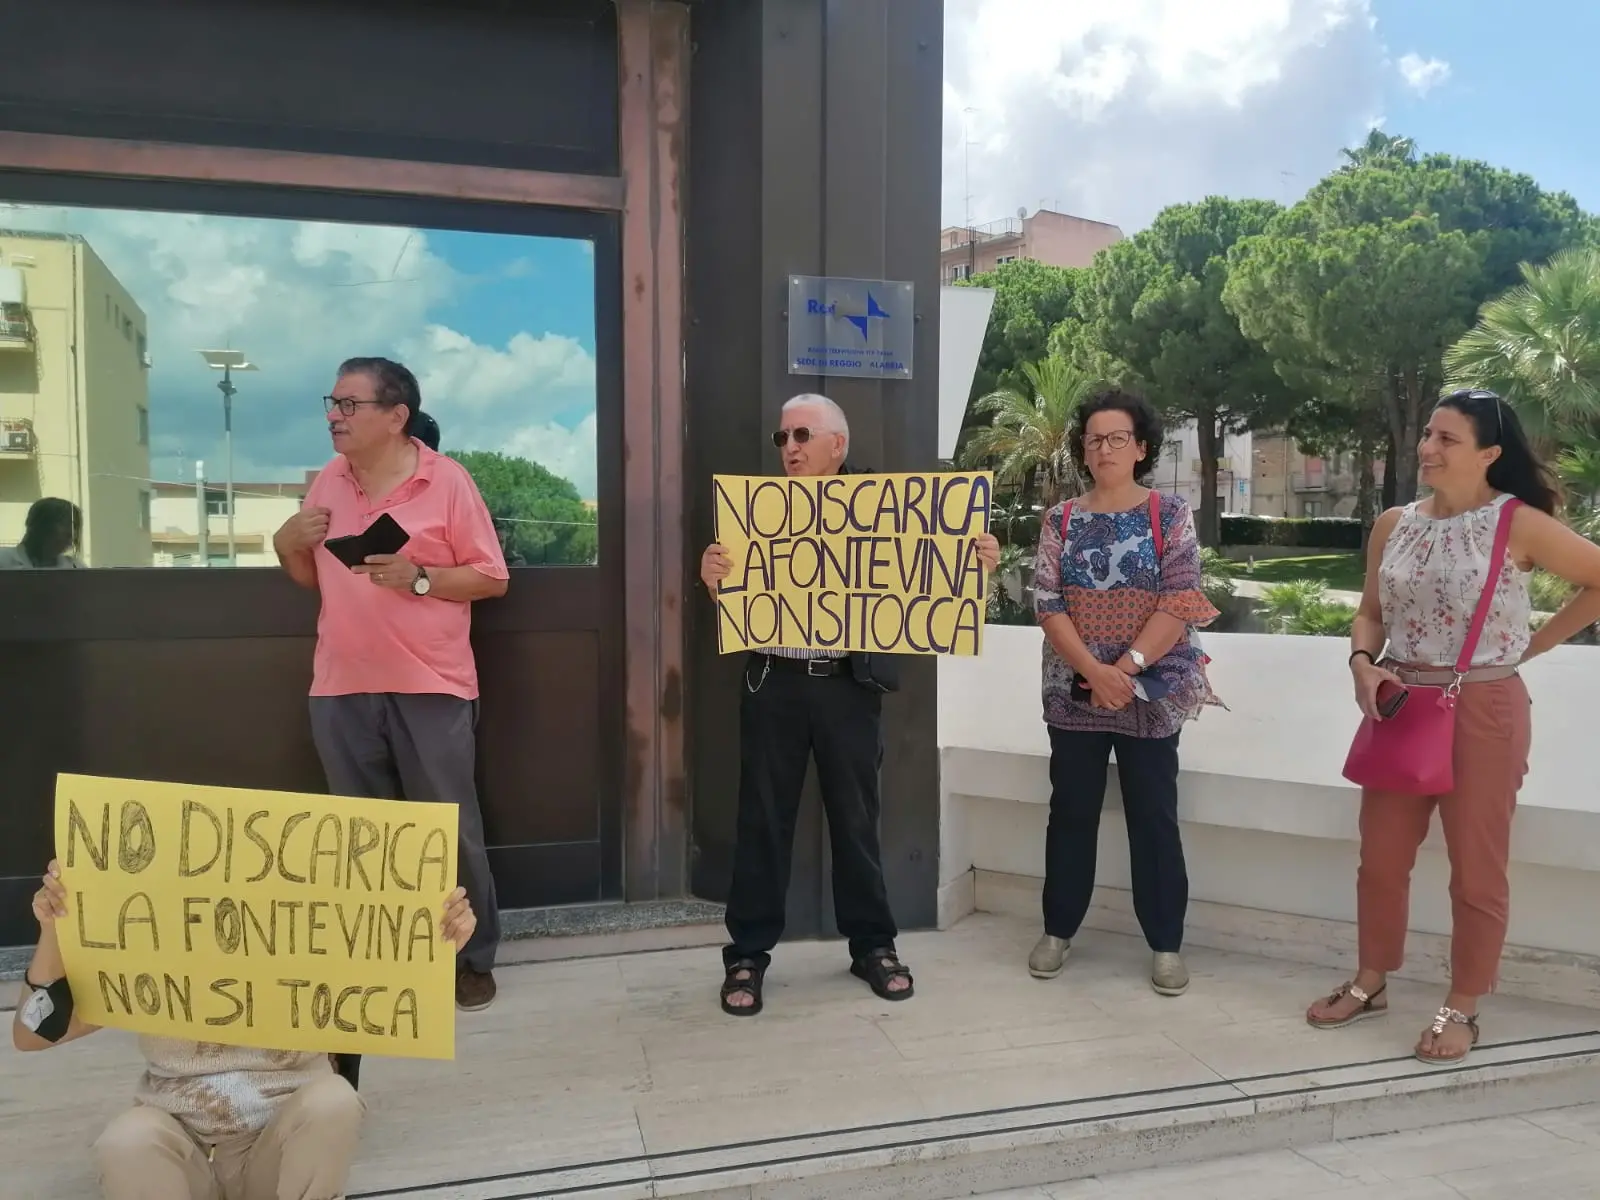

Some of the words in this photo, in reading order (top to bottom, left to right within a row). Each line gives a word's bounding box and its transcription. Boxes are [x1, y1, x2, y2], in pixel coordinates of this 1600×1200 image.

[796, 357, 816, 366] SEDE
[830, 359, 862, 368] REGGIO
[67, 799, 155, 874] NO
[178, 799, 449, 892] DISCARICA
[77, 891, 160, 951] LA
[182, 897, 434, 962] FONTEVINA
[98, 970, 193, 1023] NON
[205, 978, 254, 1027] SI
[277, 979, 419, 1039] TOCCA
